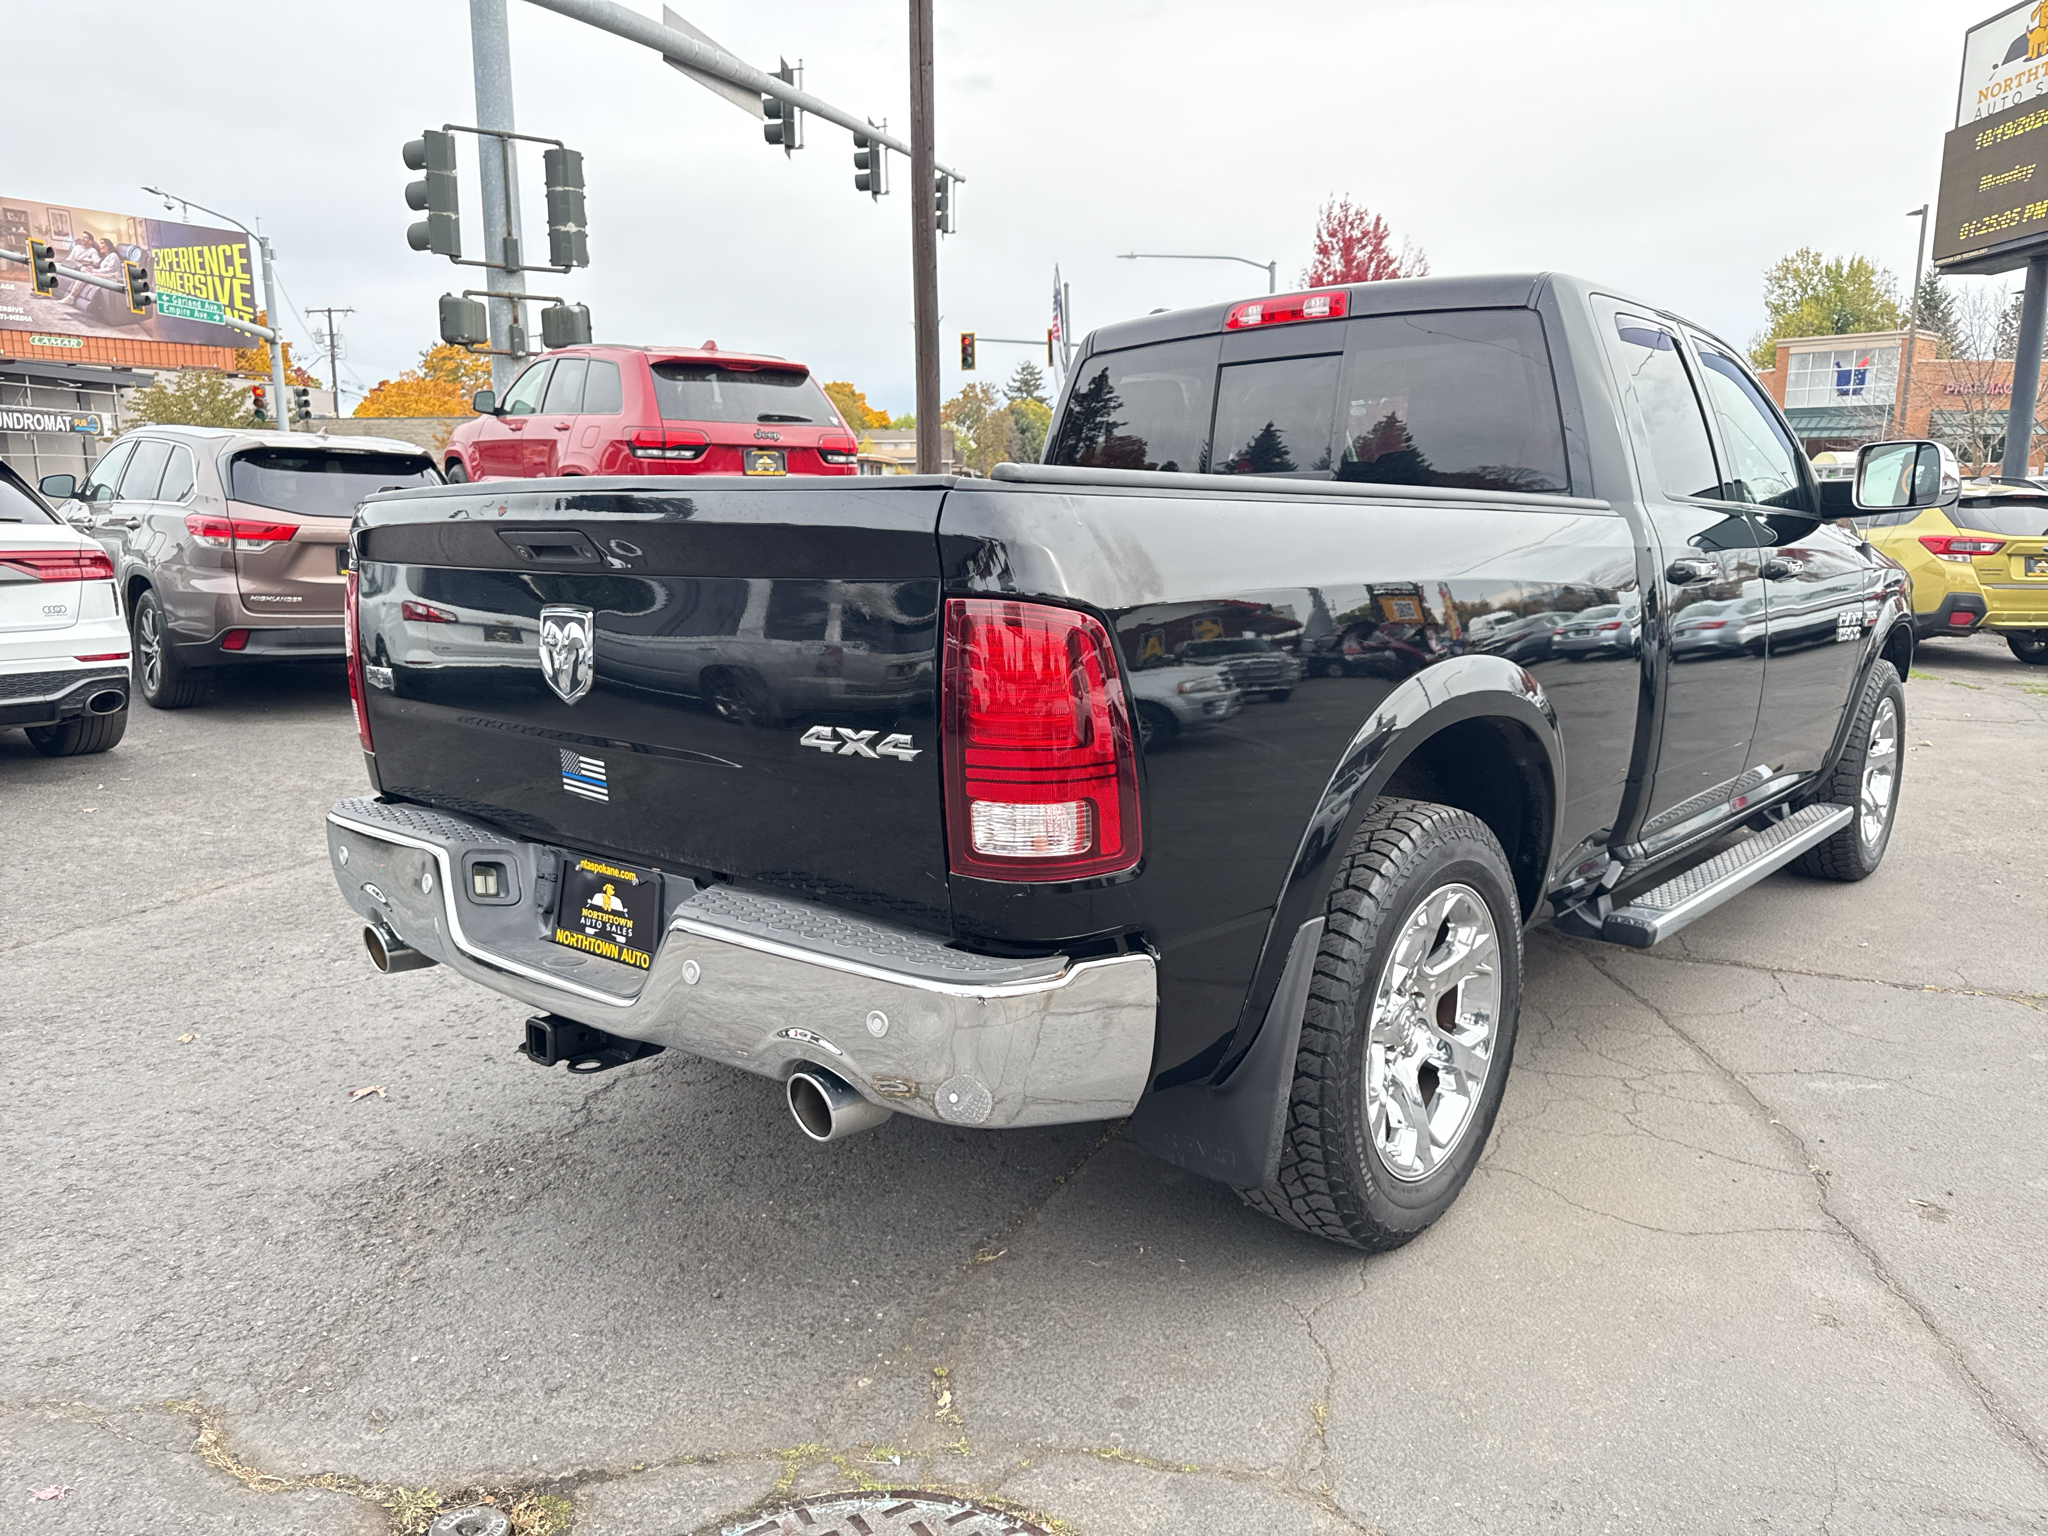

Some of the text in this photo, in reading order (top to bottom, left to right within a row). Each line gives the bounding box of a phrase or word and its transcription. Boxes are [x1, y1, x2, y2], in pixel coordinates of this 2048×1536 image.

[1974, 91, 2022, 122] AUTO
[152, 243, 251, 279] EXPERIENCE
[154, 270, 254, 313] IMMERSIVE
[163, 304, 210, 319] Empire Ave.
[172, 295, 220, 312] Garland Ave.
[34, 337, 78, 347] LAMAR
[754, 429, 781, 442] Jeep
[250, 595, 303, 603] HIGHLANDER
[801, 725, 923, 762] 4X4
[580, 859, 637, 881] ntaspokane.com
[580, 916, 633, 937] AUTO SALES
[581, 908, 633, 928] NORTHTOWN
[556, 928, 649, 969] NORTHTOWN AUTO
